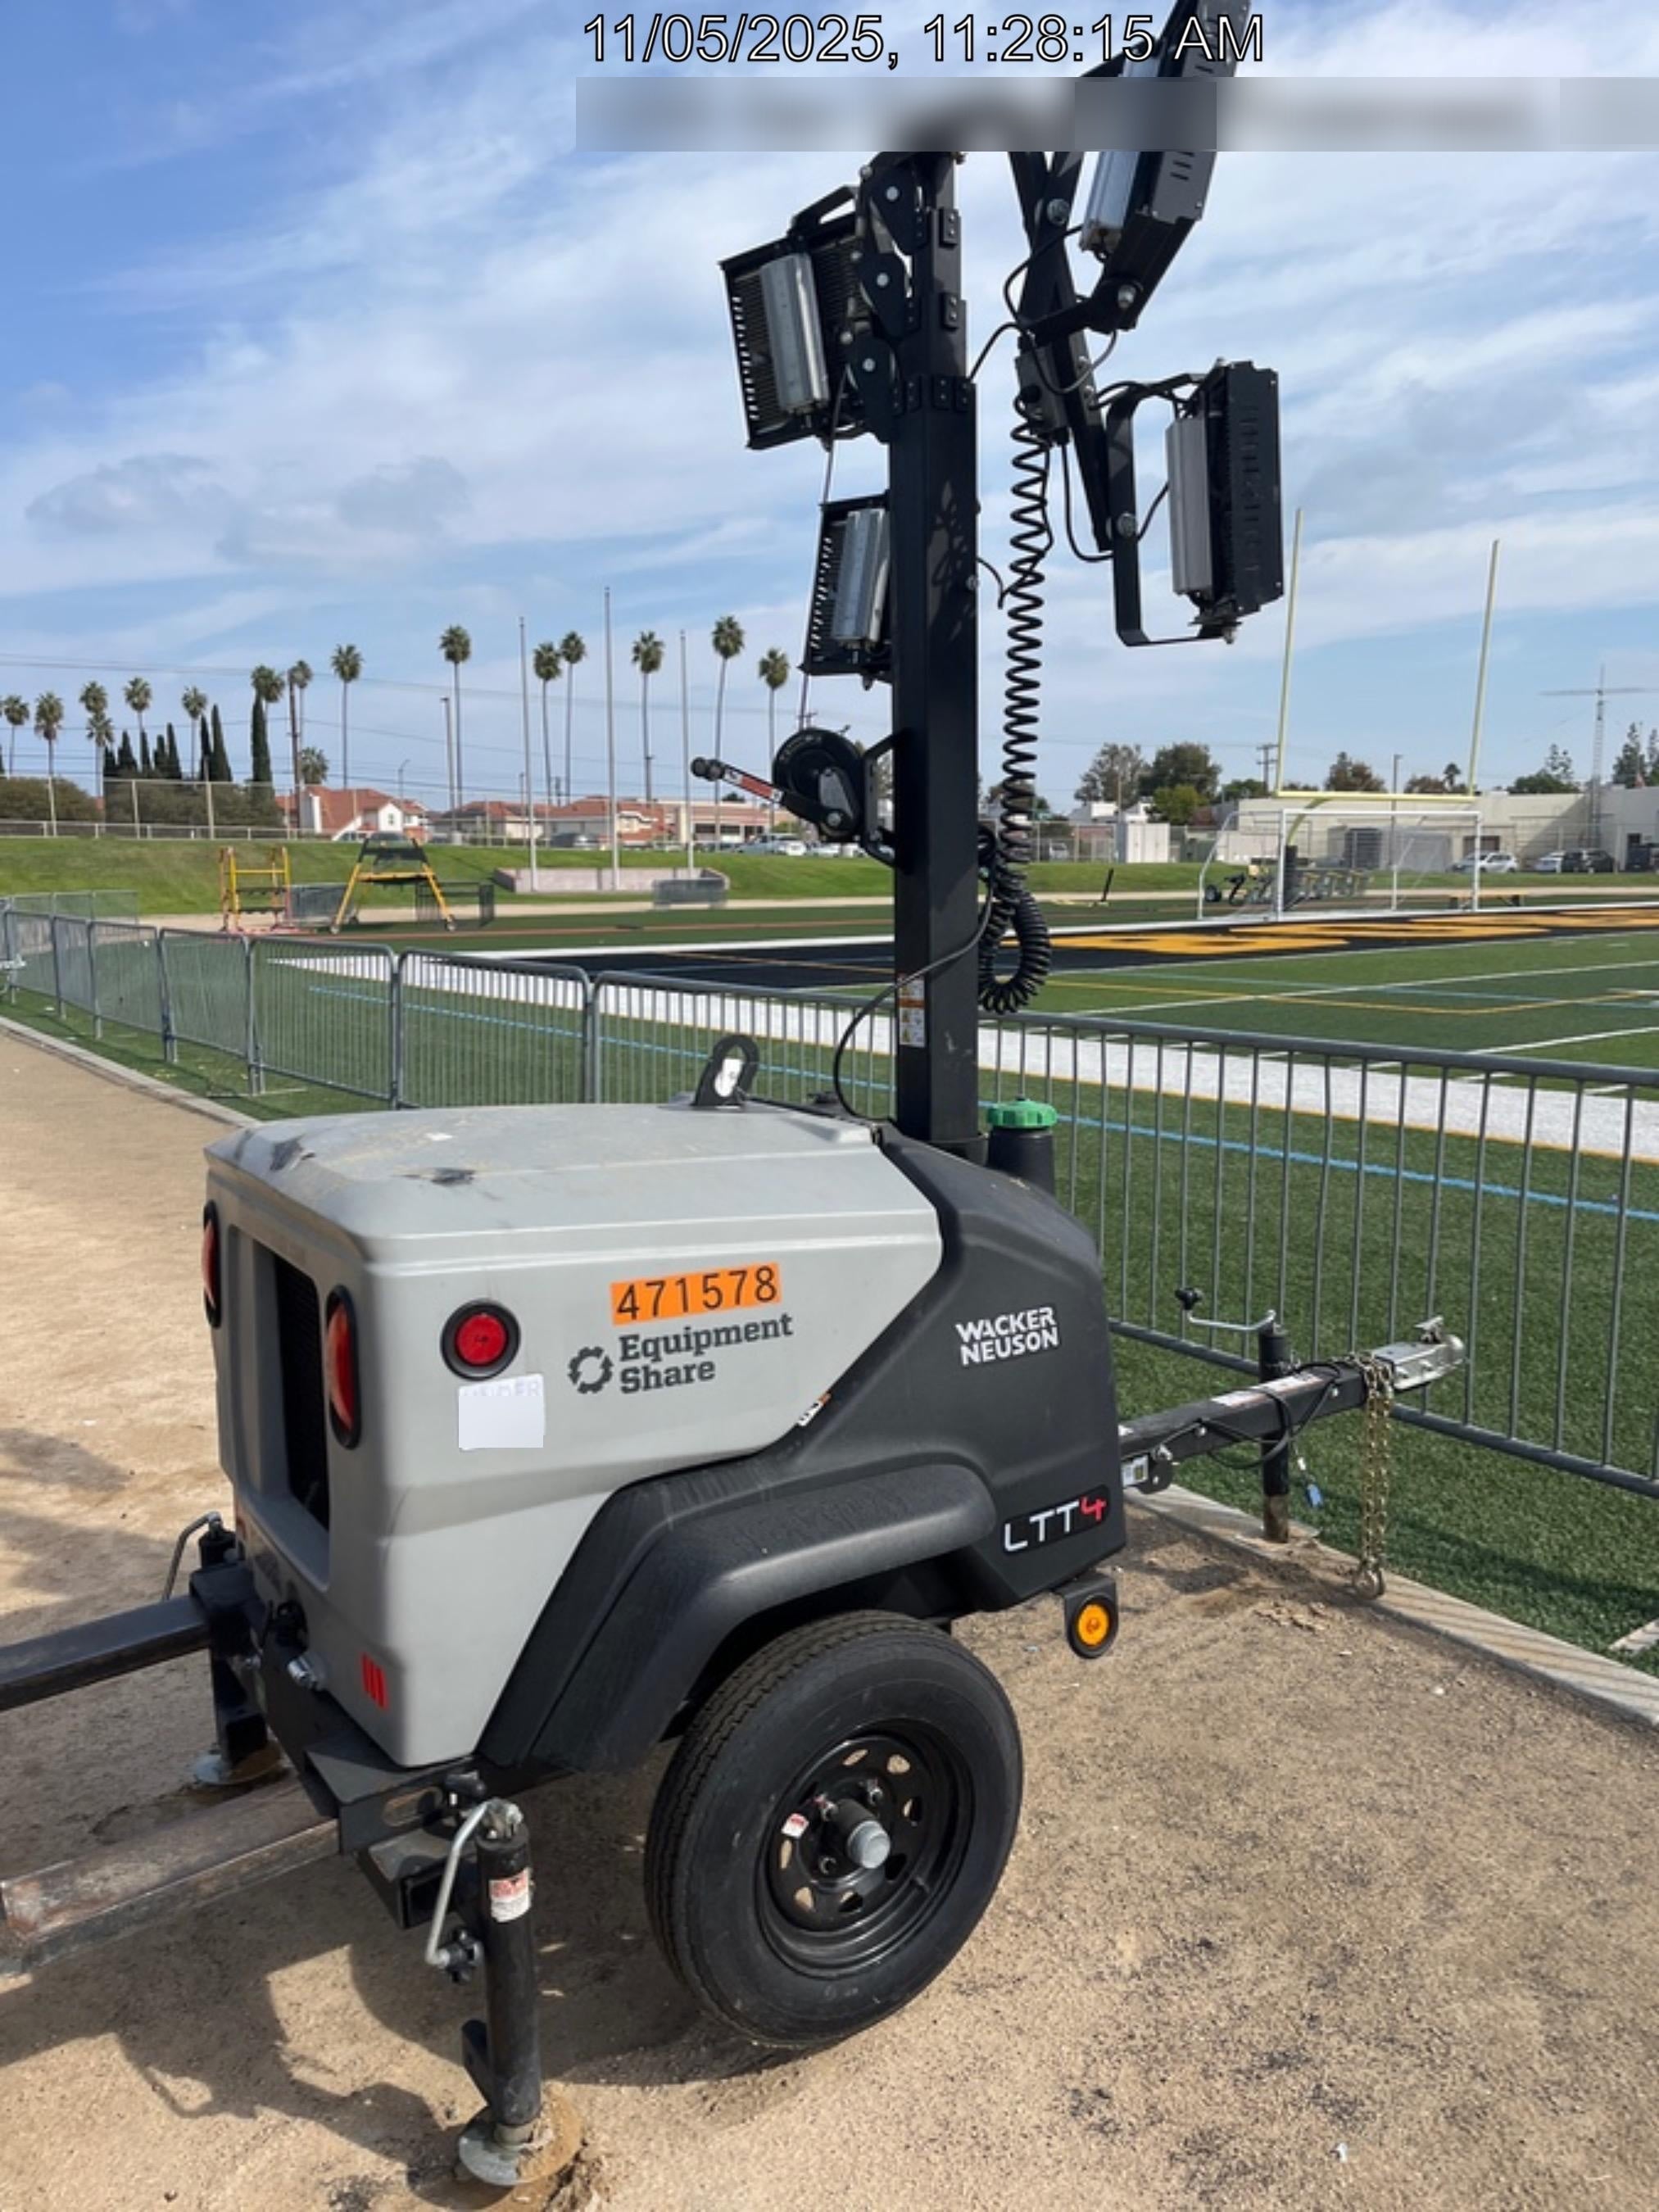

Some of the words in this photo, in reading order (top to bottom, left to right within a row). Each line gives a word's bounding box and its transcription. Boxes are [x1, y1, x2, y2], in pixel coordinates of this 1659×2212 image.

[617, 1266, 777, 1321] 471578
[619, 1312, 794, 1363] Equipment
[955, 1307, 1057, 1344] WACKER
[960, 1326, 1058, 1367] NEUSON
[620, 1358, 716, 1394] Share
[1004, 1496, 1106, 1552] LTT4
